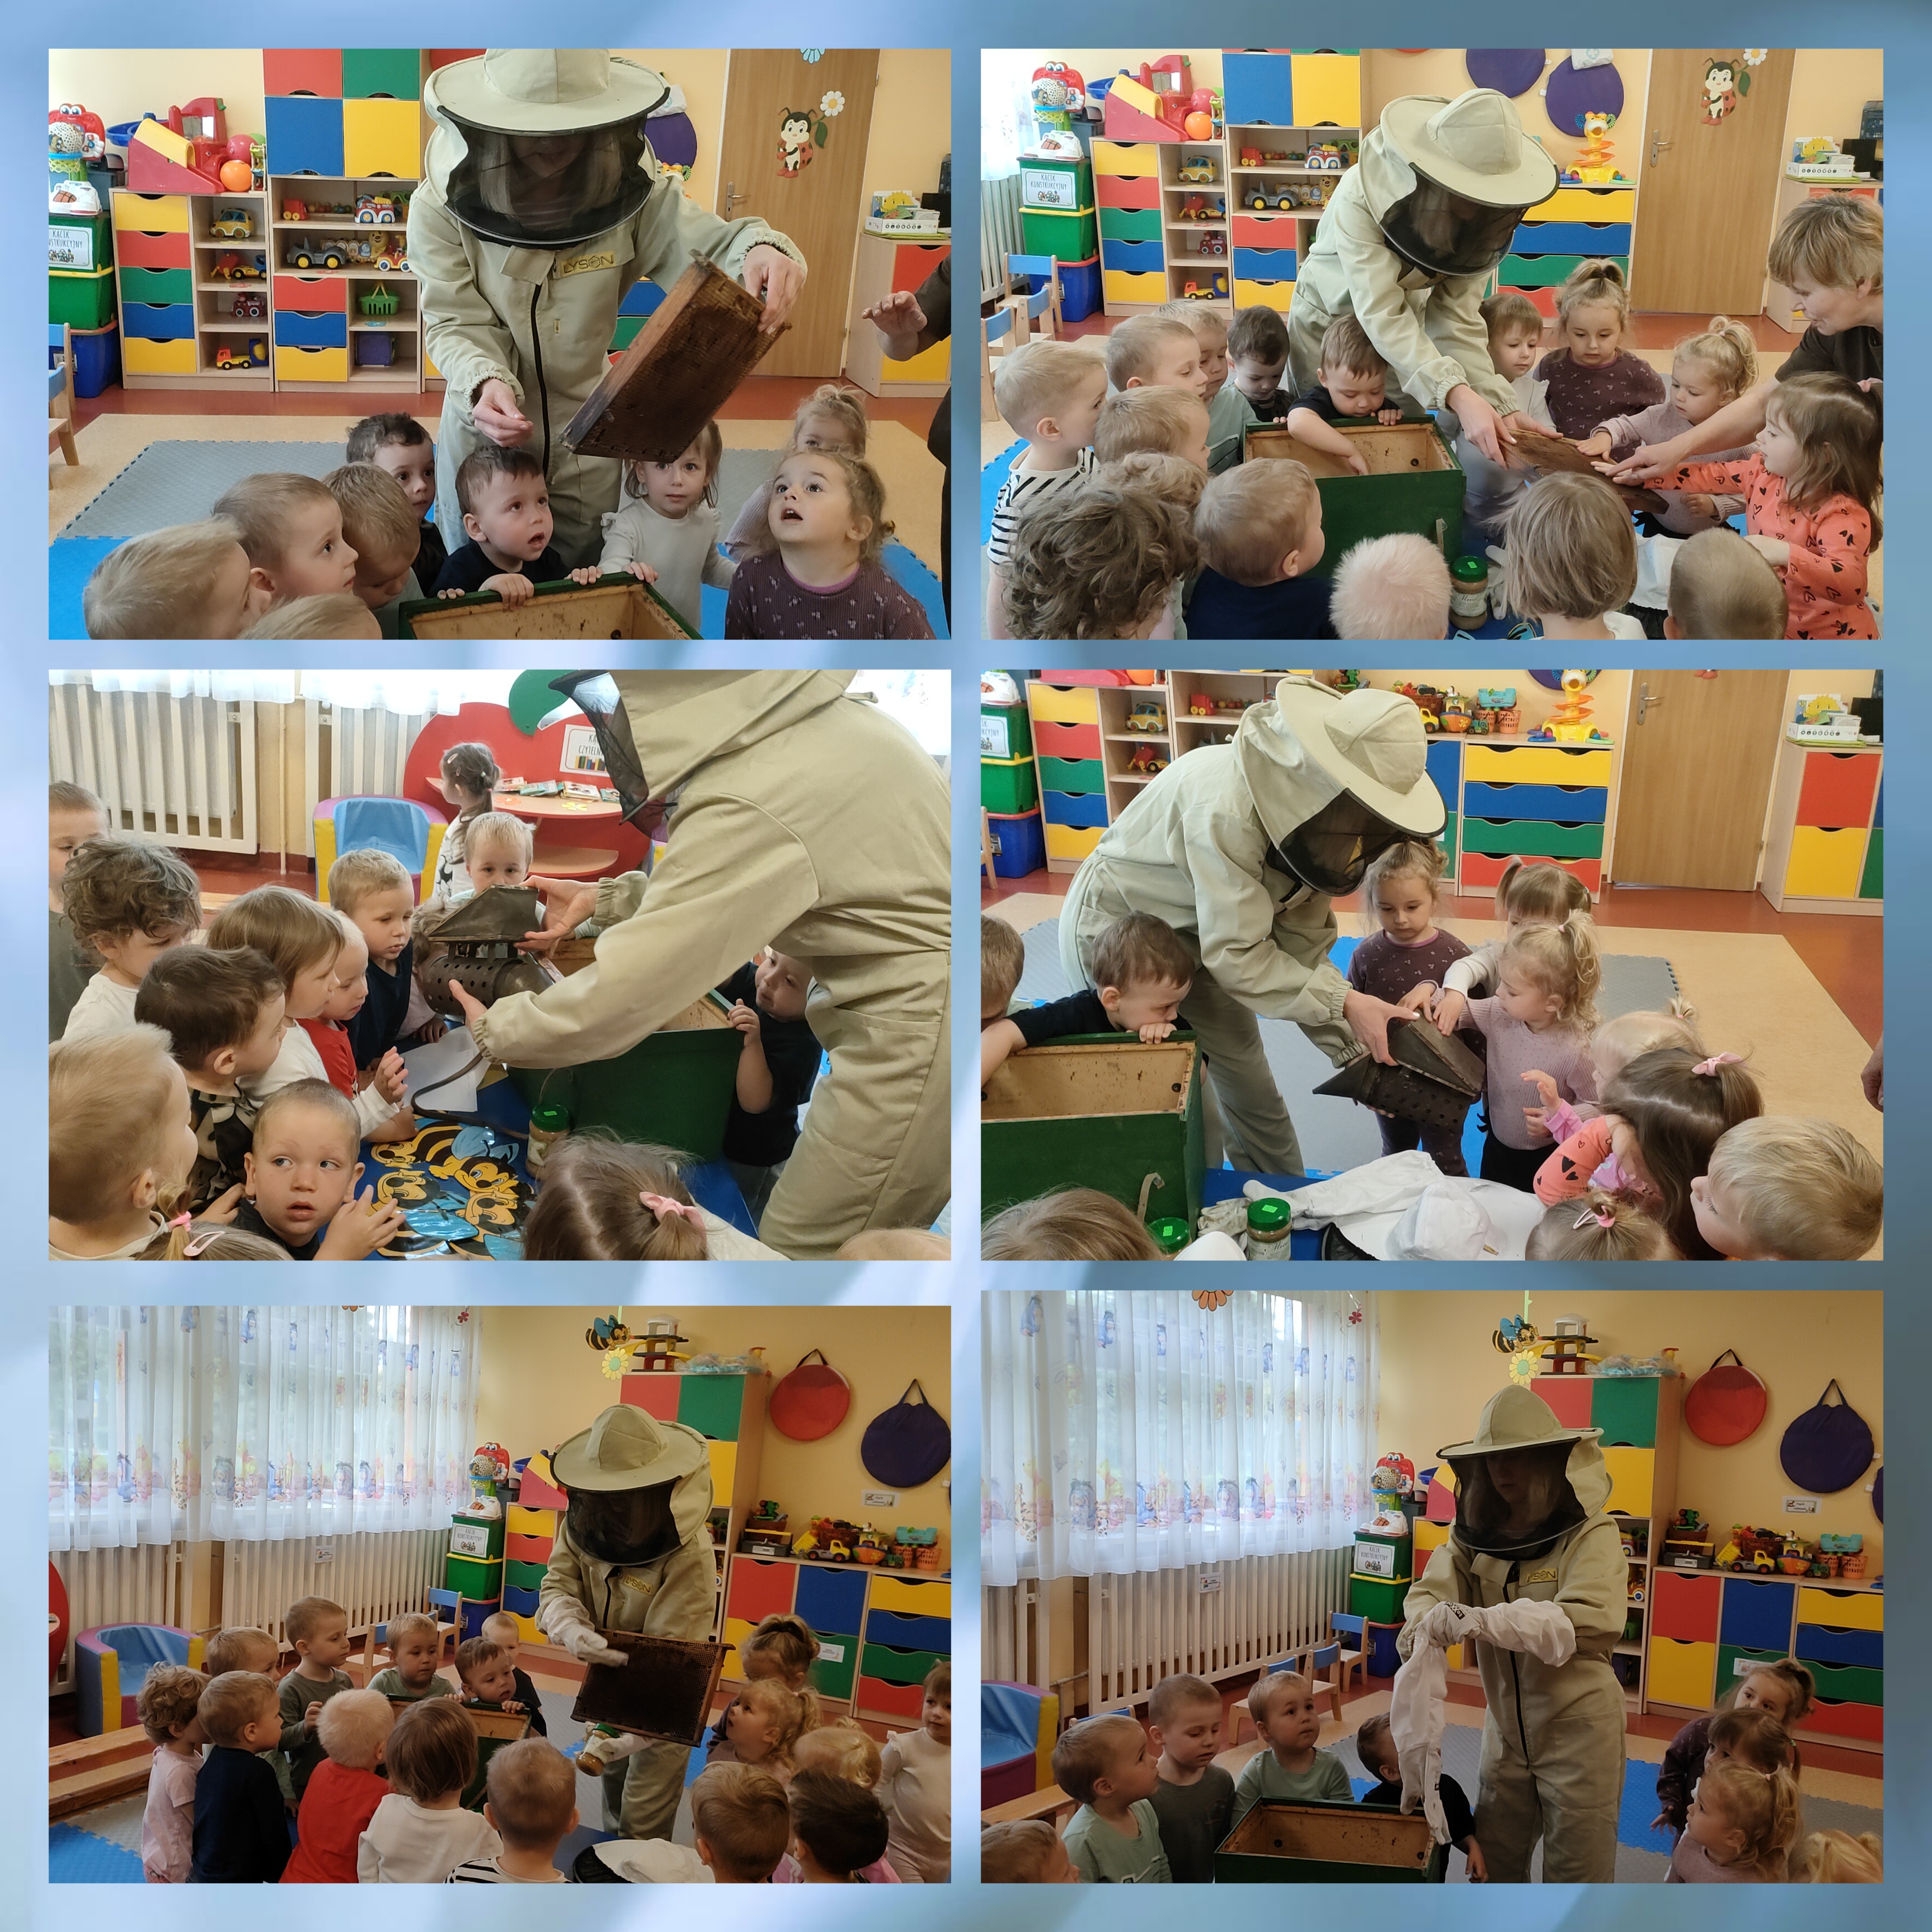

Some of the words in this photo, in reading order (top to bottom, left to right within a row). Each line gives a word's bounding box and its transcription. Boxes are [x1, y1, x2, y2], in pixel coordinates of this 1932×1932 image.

[1041, 174, 1056, 182] KĄCIK
[1031, 181, 1066, 191] KONSTRUKCYJNY
[53, 230, 70, 239] KĄCIK
[563, 254, 614, 274] LYSON
[1527, 1570, 1556, 1583] LSON
